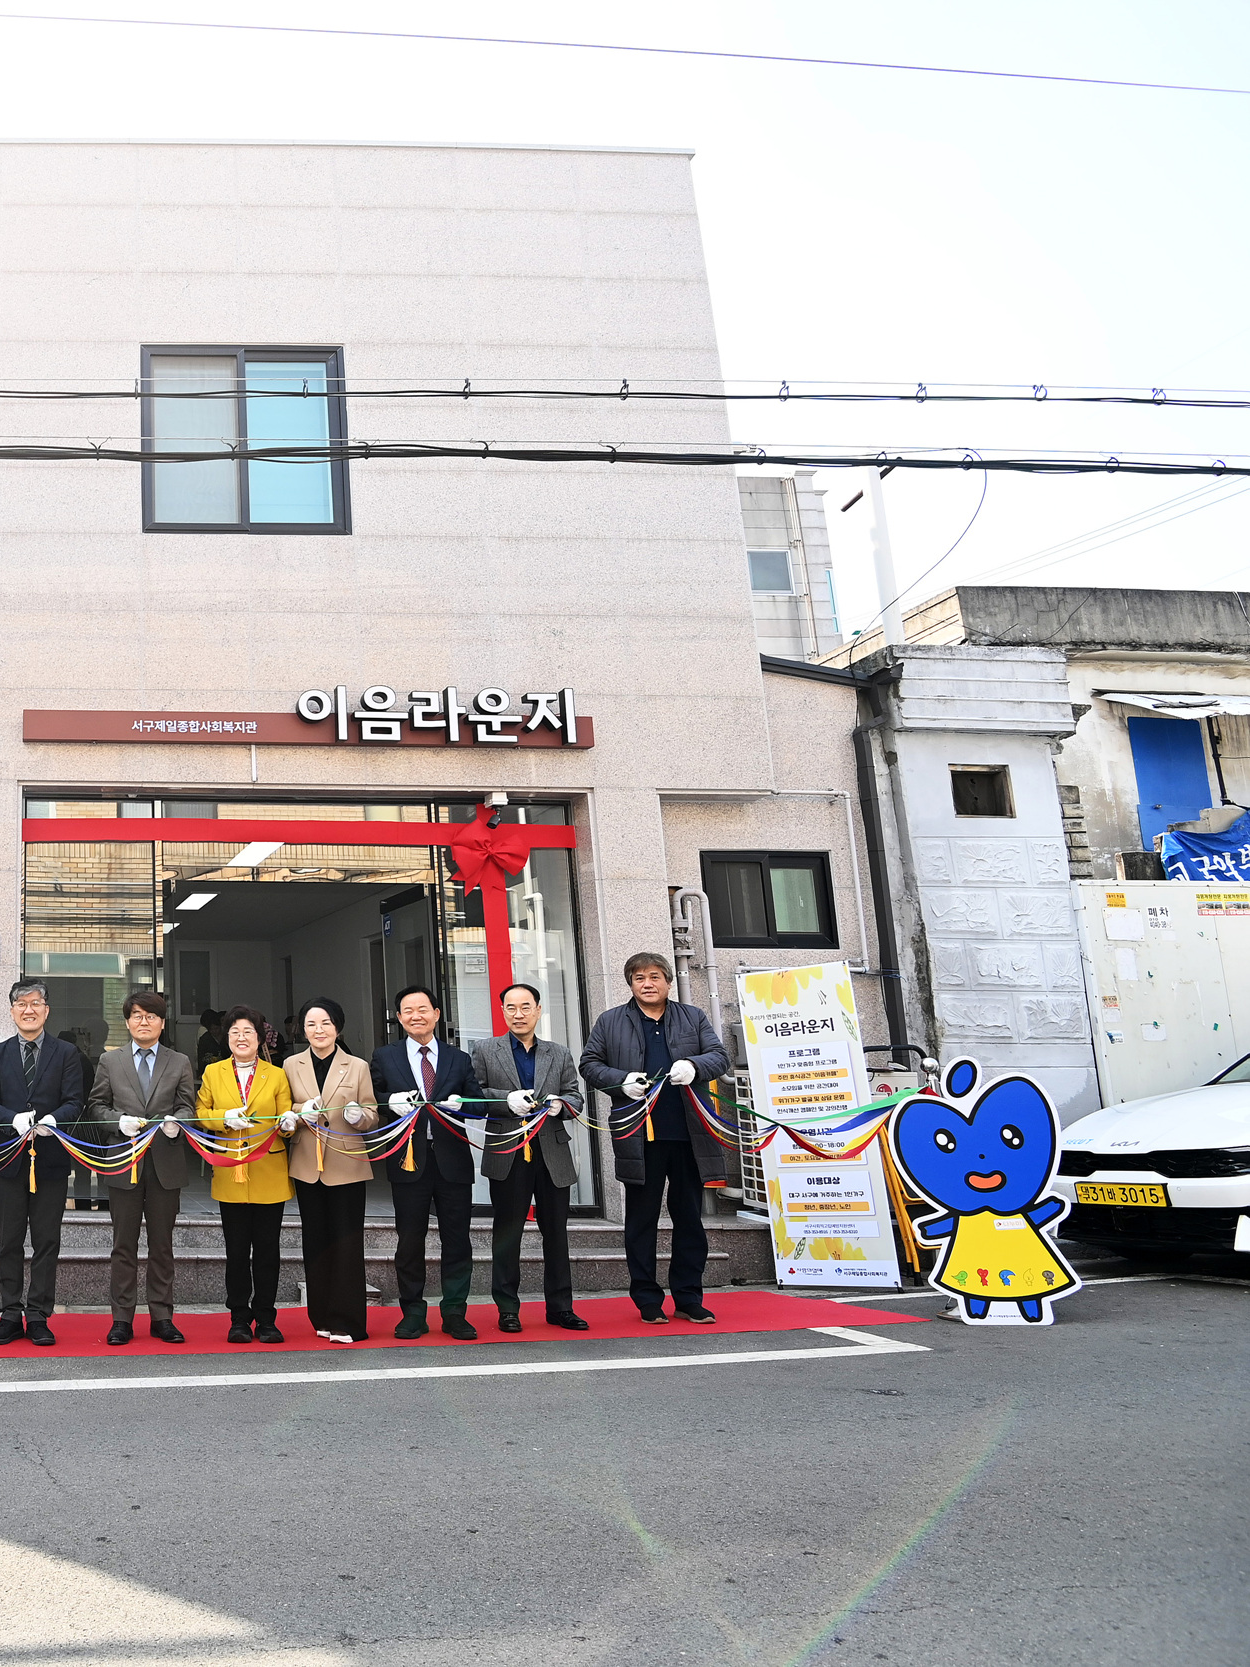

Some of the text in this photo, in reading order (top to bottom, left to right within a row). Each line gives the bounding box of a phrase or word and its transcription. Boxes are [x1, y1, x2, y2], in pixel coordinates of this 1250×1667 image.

[297, 685, 577, 745] 이음라운지
[131, 719, 257, 734] 서구제일종합사회복지관
[764, 1017, 835, 1037] 이음라운지
[788, 1048, 821, 1058] 프로그램
[806, 1176, 840, 1186] 이용대상
[1118, 1187, 1160, 1204] 3015
